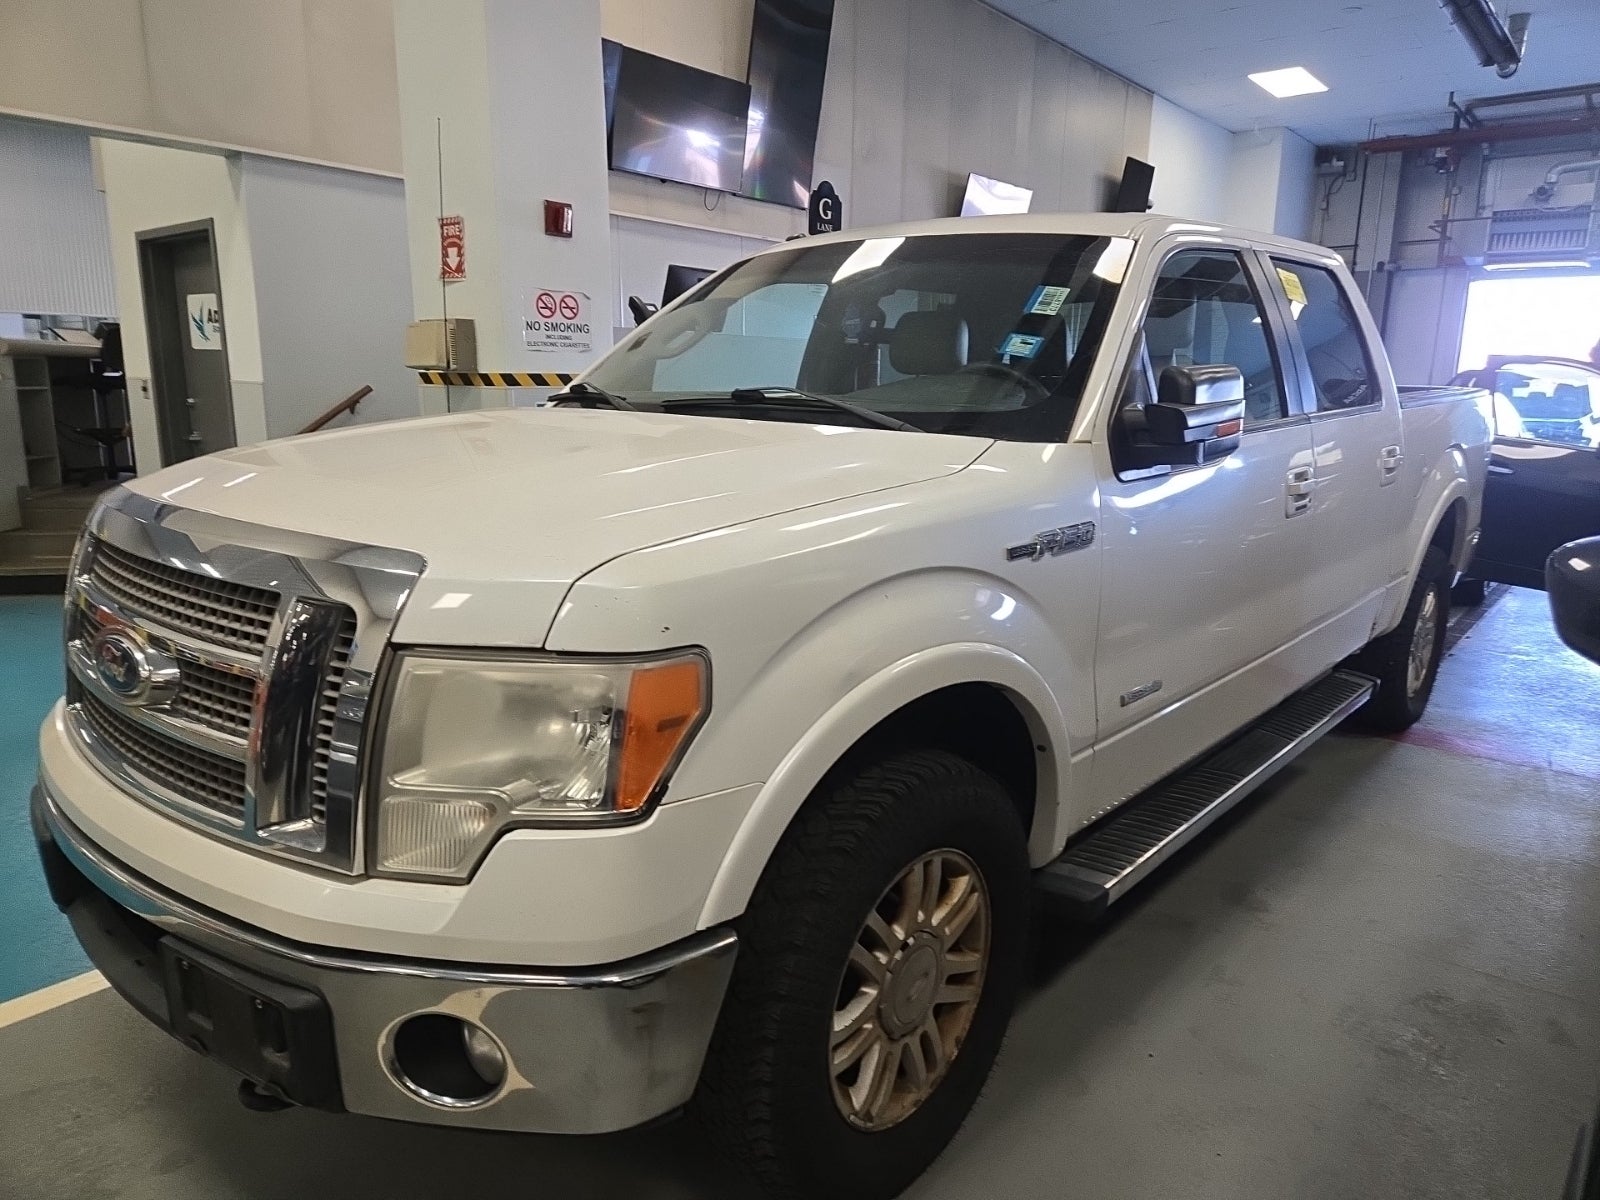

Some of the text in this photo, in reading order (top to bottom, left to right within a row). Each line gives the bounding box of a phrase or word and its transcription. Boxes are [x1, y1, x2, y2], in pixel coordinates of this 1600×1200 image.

[818, 197, 832, 220] G
[443, 224, 461, 236] FIRE
[816, 222, 833, 232] LANE
[525, 320, 590, 334] NO SMOKING
[545, 333, 573, 341] INCLUDING
